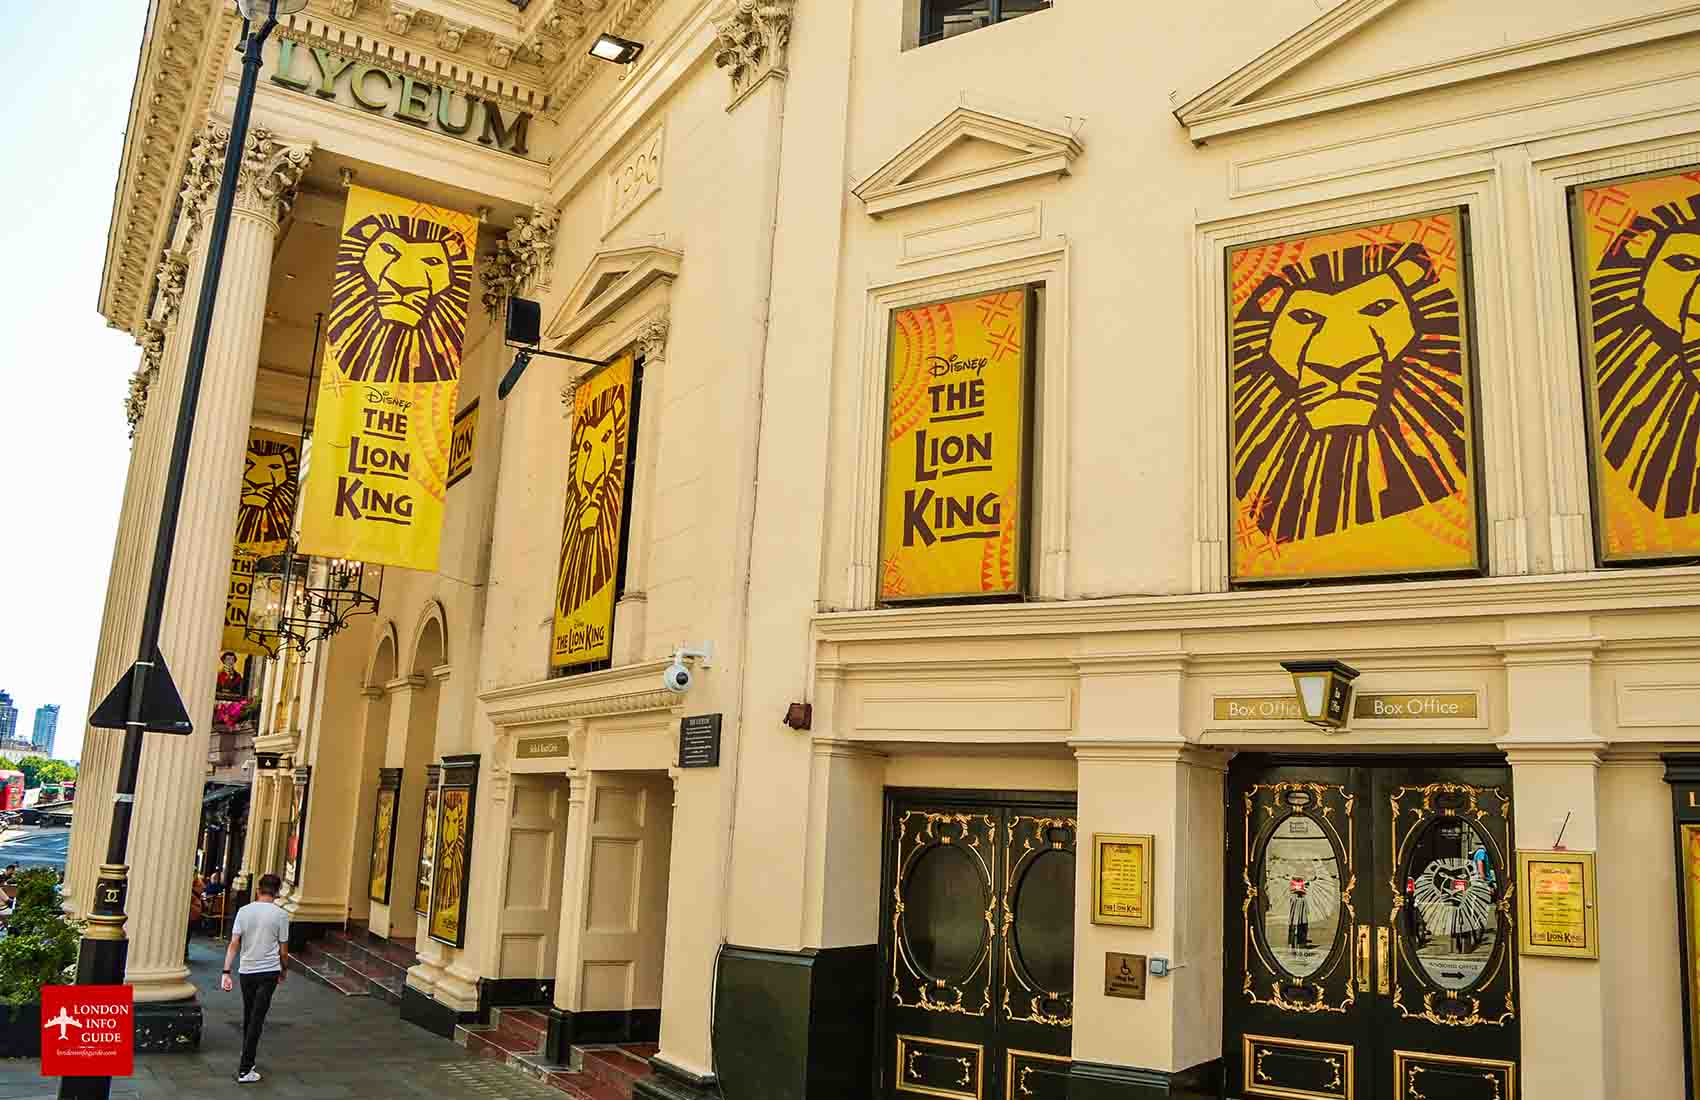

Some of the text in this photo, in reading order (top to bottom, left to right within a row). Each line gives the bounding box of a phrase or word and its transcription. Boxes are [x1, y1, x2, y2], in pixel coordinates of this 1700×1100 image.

[270, 37, 534, 155] LYCEUM
[927, 379, 985, 423] THE
[363, 408, 408, 440] THE
[348, 436, 412, 480] LION
[448, 424, 474, 478] LION
[914, 430, 993, 482] LION
[335, 476, 414, 526] KING
[902, 487, 1001, 548] KING
[557, 635, 568, 654] THE
[585, 624, 604, 650] KING
[1230, 702, 1256, 716] Box
[1374, 696, 1460, 715] Box Office
